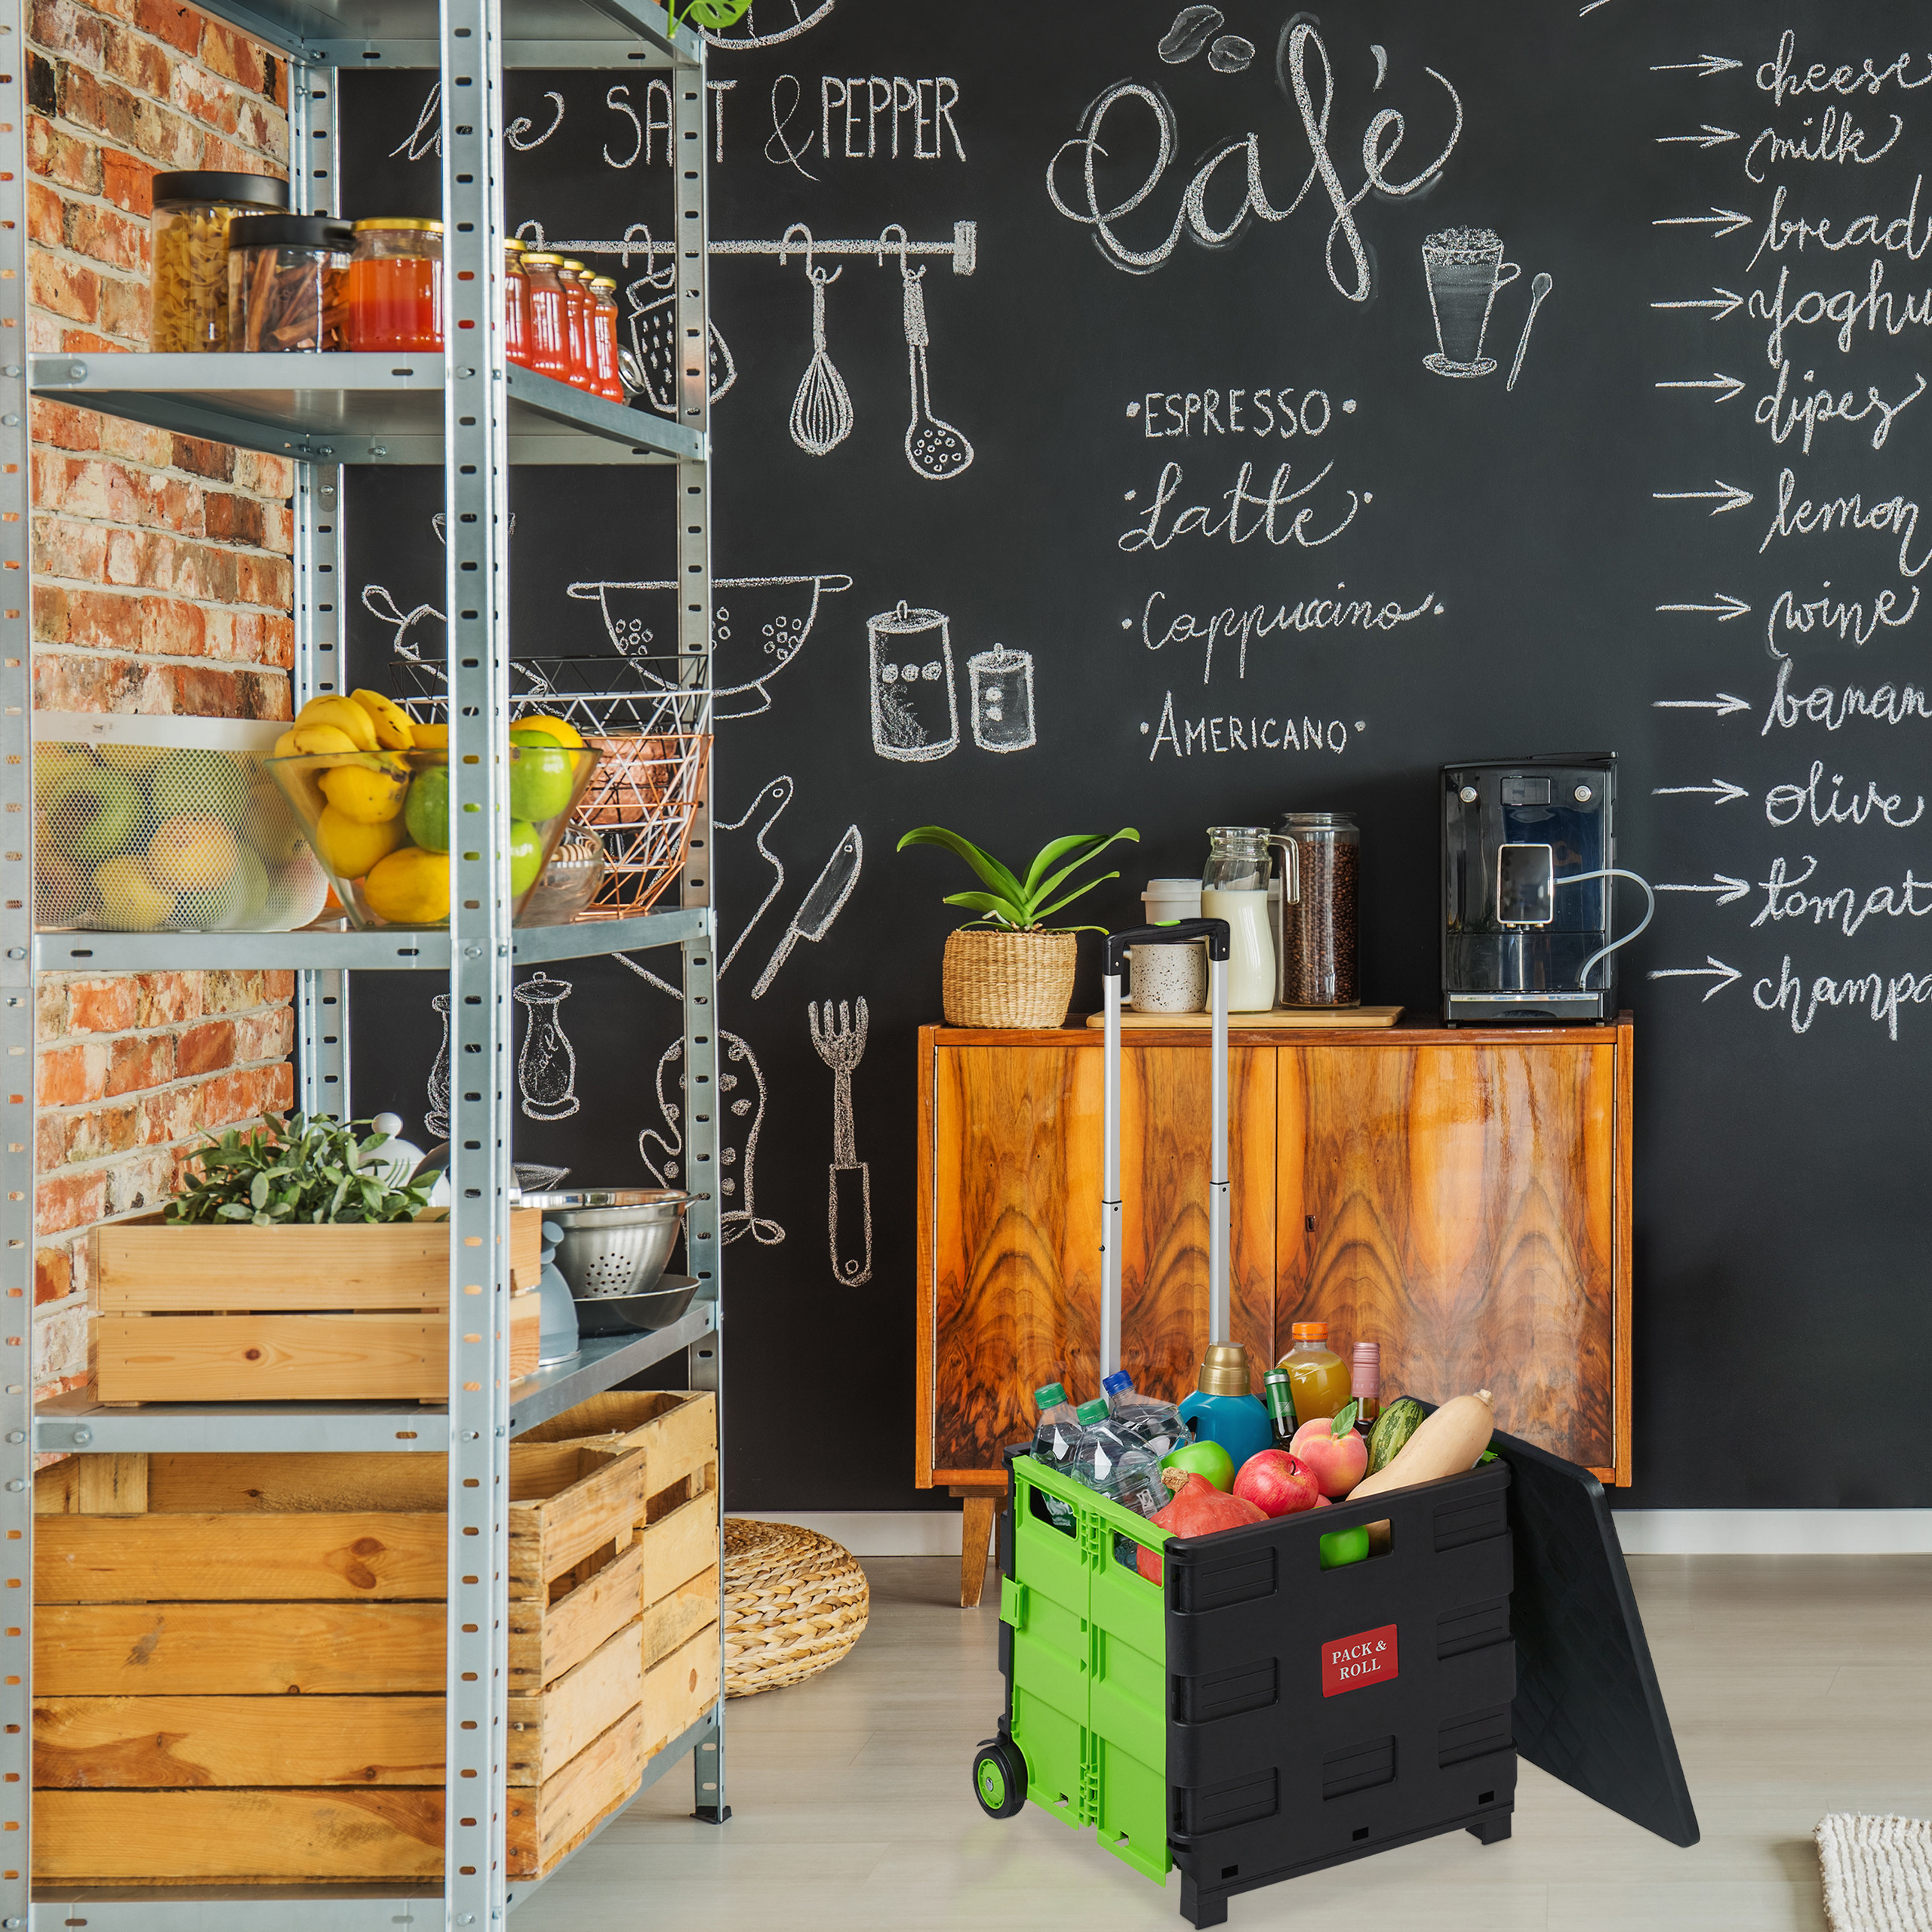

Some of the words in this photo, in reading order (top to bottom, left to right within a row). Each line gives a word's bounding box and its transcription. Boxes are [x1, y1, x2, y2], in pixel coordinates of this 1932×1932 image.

[604, 78, 737, 168] SAT
[764, 75, 820, 182] &
[822, 75, 967, 162] PEPPER
[1745, 105, 1903, 183] milk
[1746, 174, 1932, 272] bread
[1145, 388, 1331, 438] ESPRESSO
[1118, 459, 1358, 552] Latte
[1759, 467, 1932, 577] lemon
[1142, 581, 1435, 685] Cappuccino
[1767, 580, 1921, 658] wine
[1765, 760, 1925, 828] olive
[1331, 1641, 1372, 1665] PACK
[1375, 1640, 1387, 1652] &
[1340, 1658, 1381, 1681] ROLL
